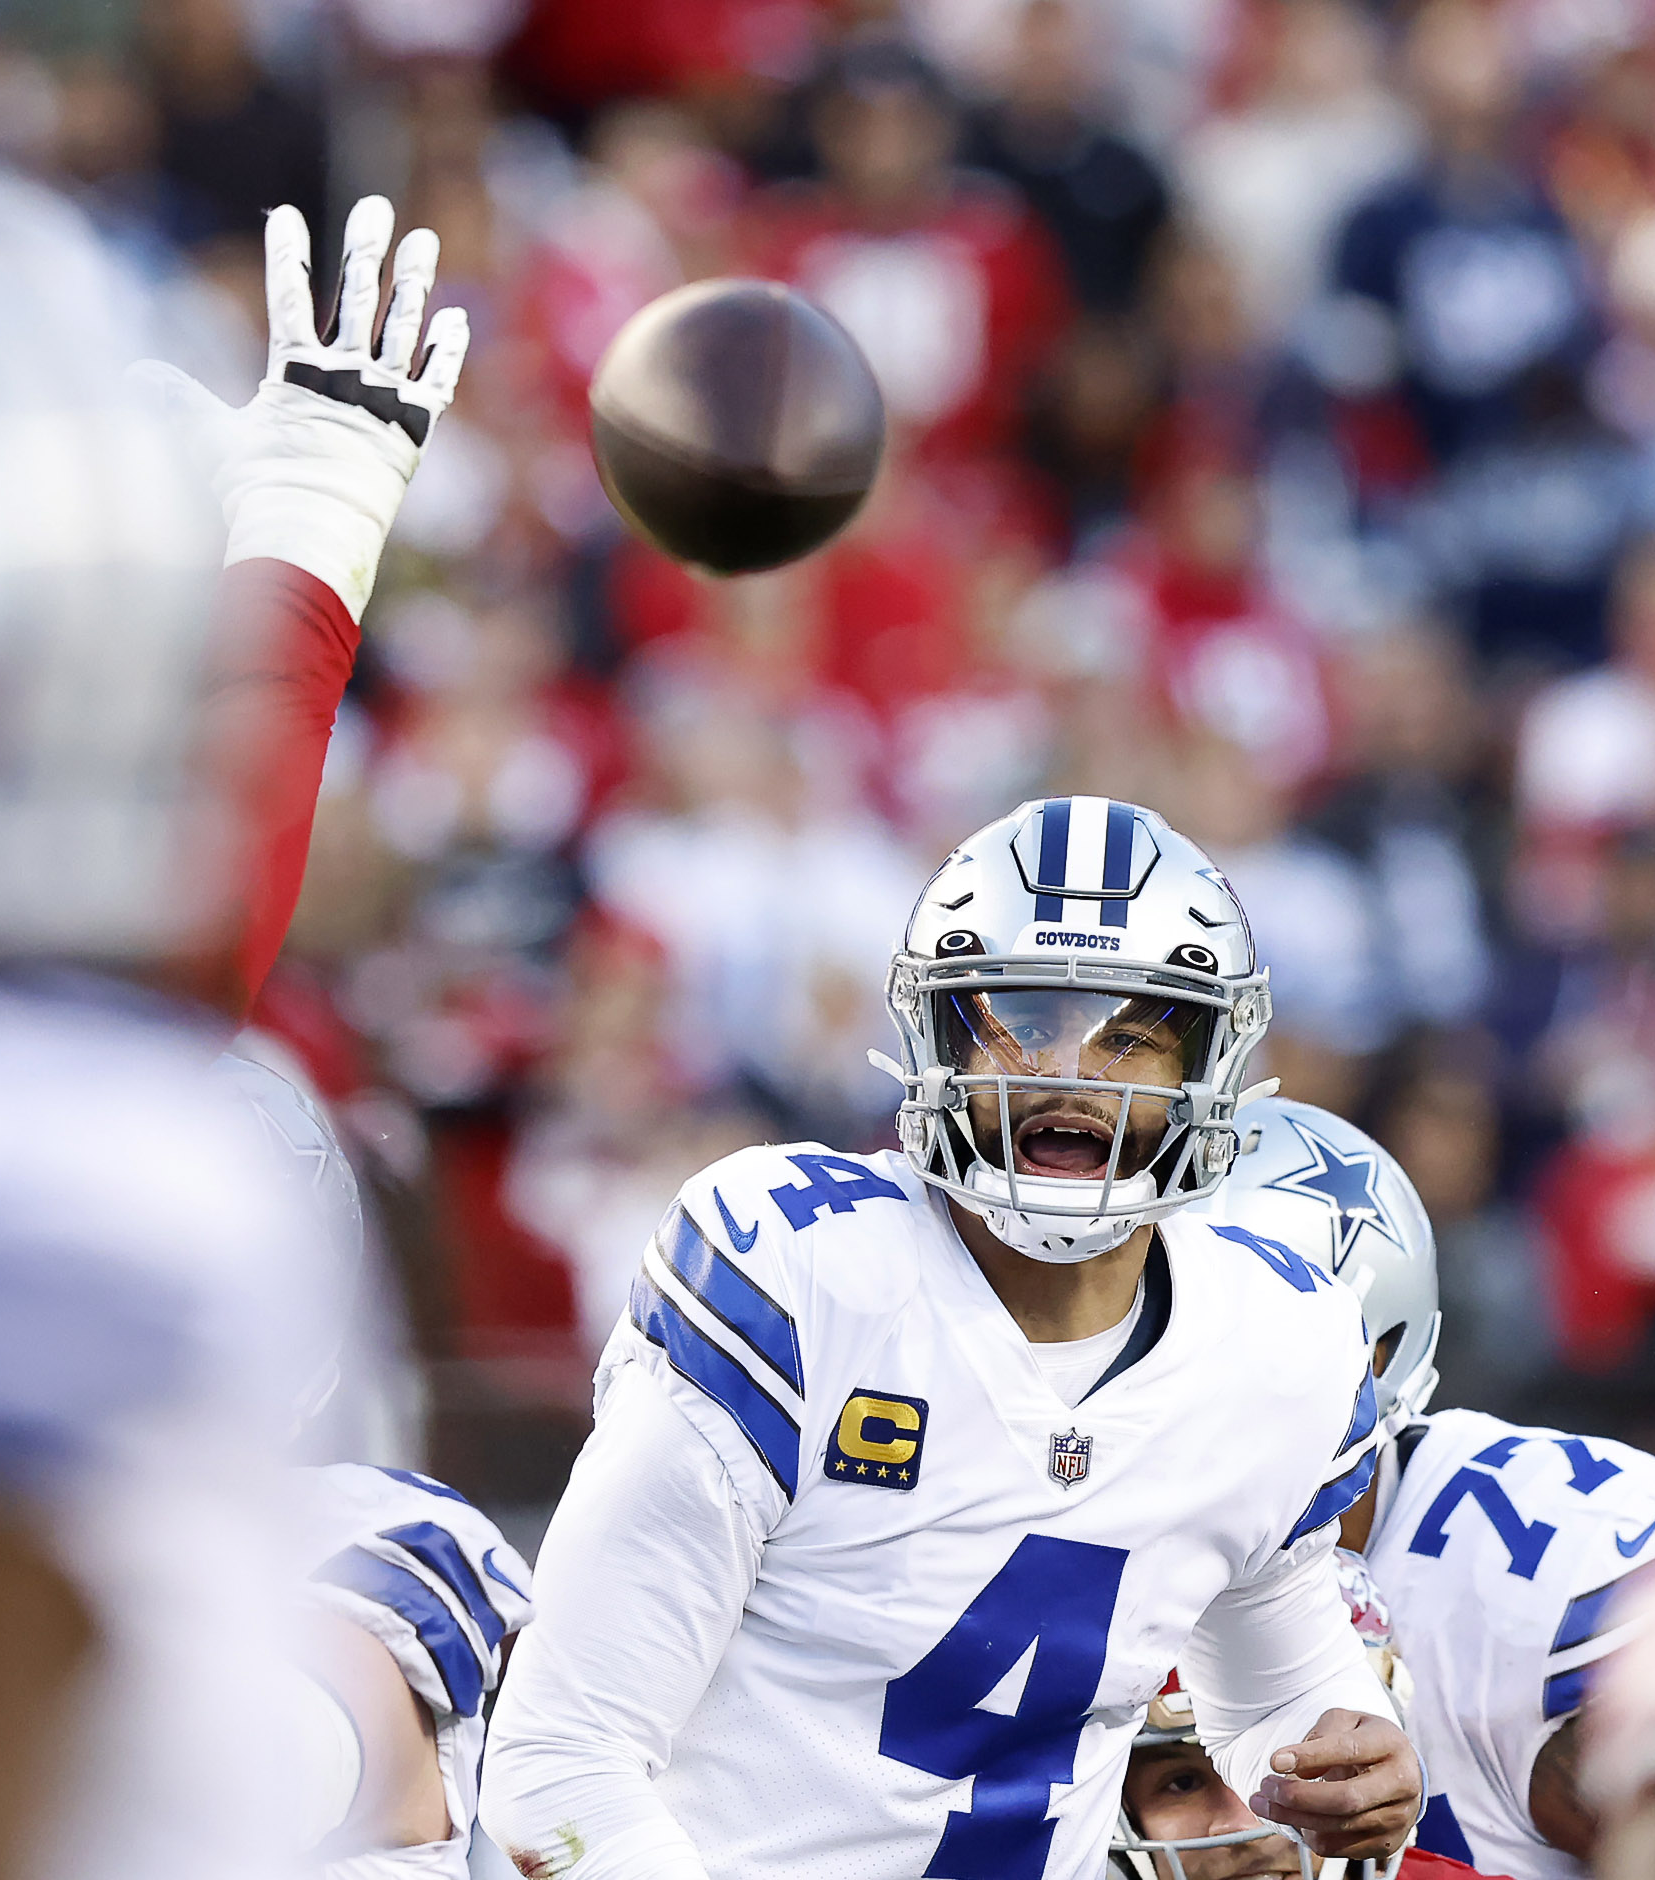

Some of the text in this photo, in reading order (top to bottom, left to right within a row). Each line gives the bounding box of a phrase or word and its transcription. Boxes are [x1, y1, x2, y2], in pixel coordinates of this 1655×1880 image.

[1035, 931, 1121, 952] COWBOYS
[771, 1153, 911, 1232] 4
[837, 1396, 920, 1464] C
[1056, 1454, 1085, 1479] NFL
[1408, 1437, 1623, 1581] 77
